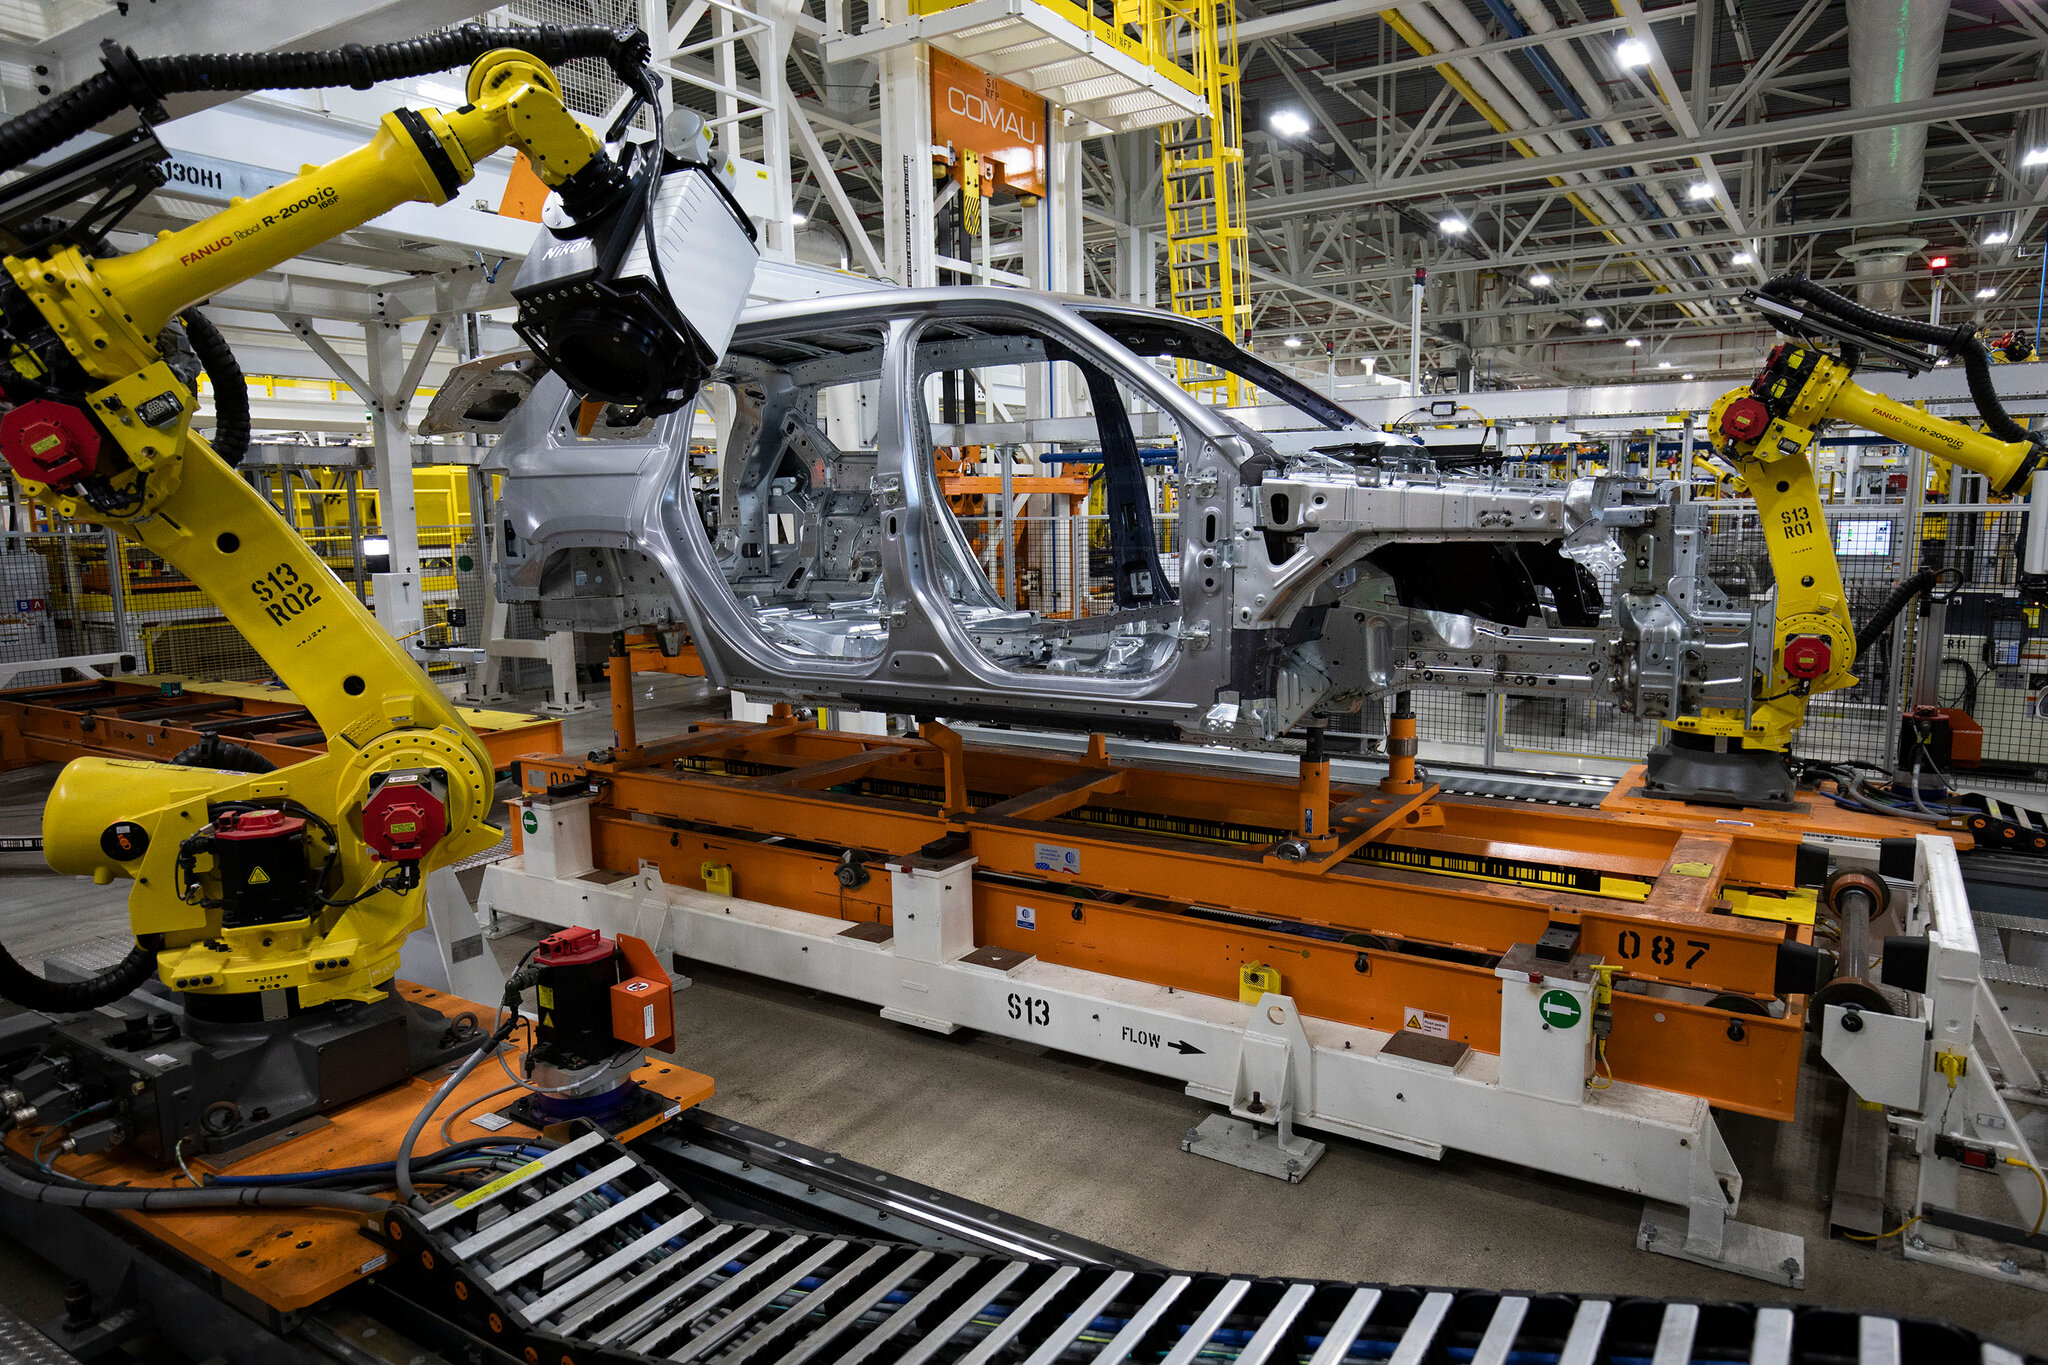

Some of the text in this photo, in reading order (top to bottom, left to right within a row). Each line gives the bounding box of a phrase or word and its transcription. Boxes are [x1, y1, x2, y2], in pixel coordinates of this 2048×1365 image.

[948, 86, 1035, 144] COMAU
[160, 161, 223, 190] 130H1
[180, 186, 336, 267] FANUC Robot R-2000iC
[541, 239, 593, 262] Nikon
[1872, 407, 1902, 424] FANUC
[1918, 426, 1965, 448] R-2000iC
[1780, 507, 1809, 525] S13
[1784, 521, 1813, 540] R01
[251, 563, 299, 602] S13
[20, 601, 42, 610] B A
[265, 582, 322, 627] R02
[1947, 639, 1966, 650] R11
[1618, 930, 1710, 970] 087
[1008, 992, 1161, 1049] S13 FLOW
